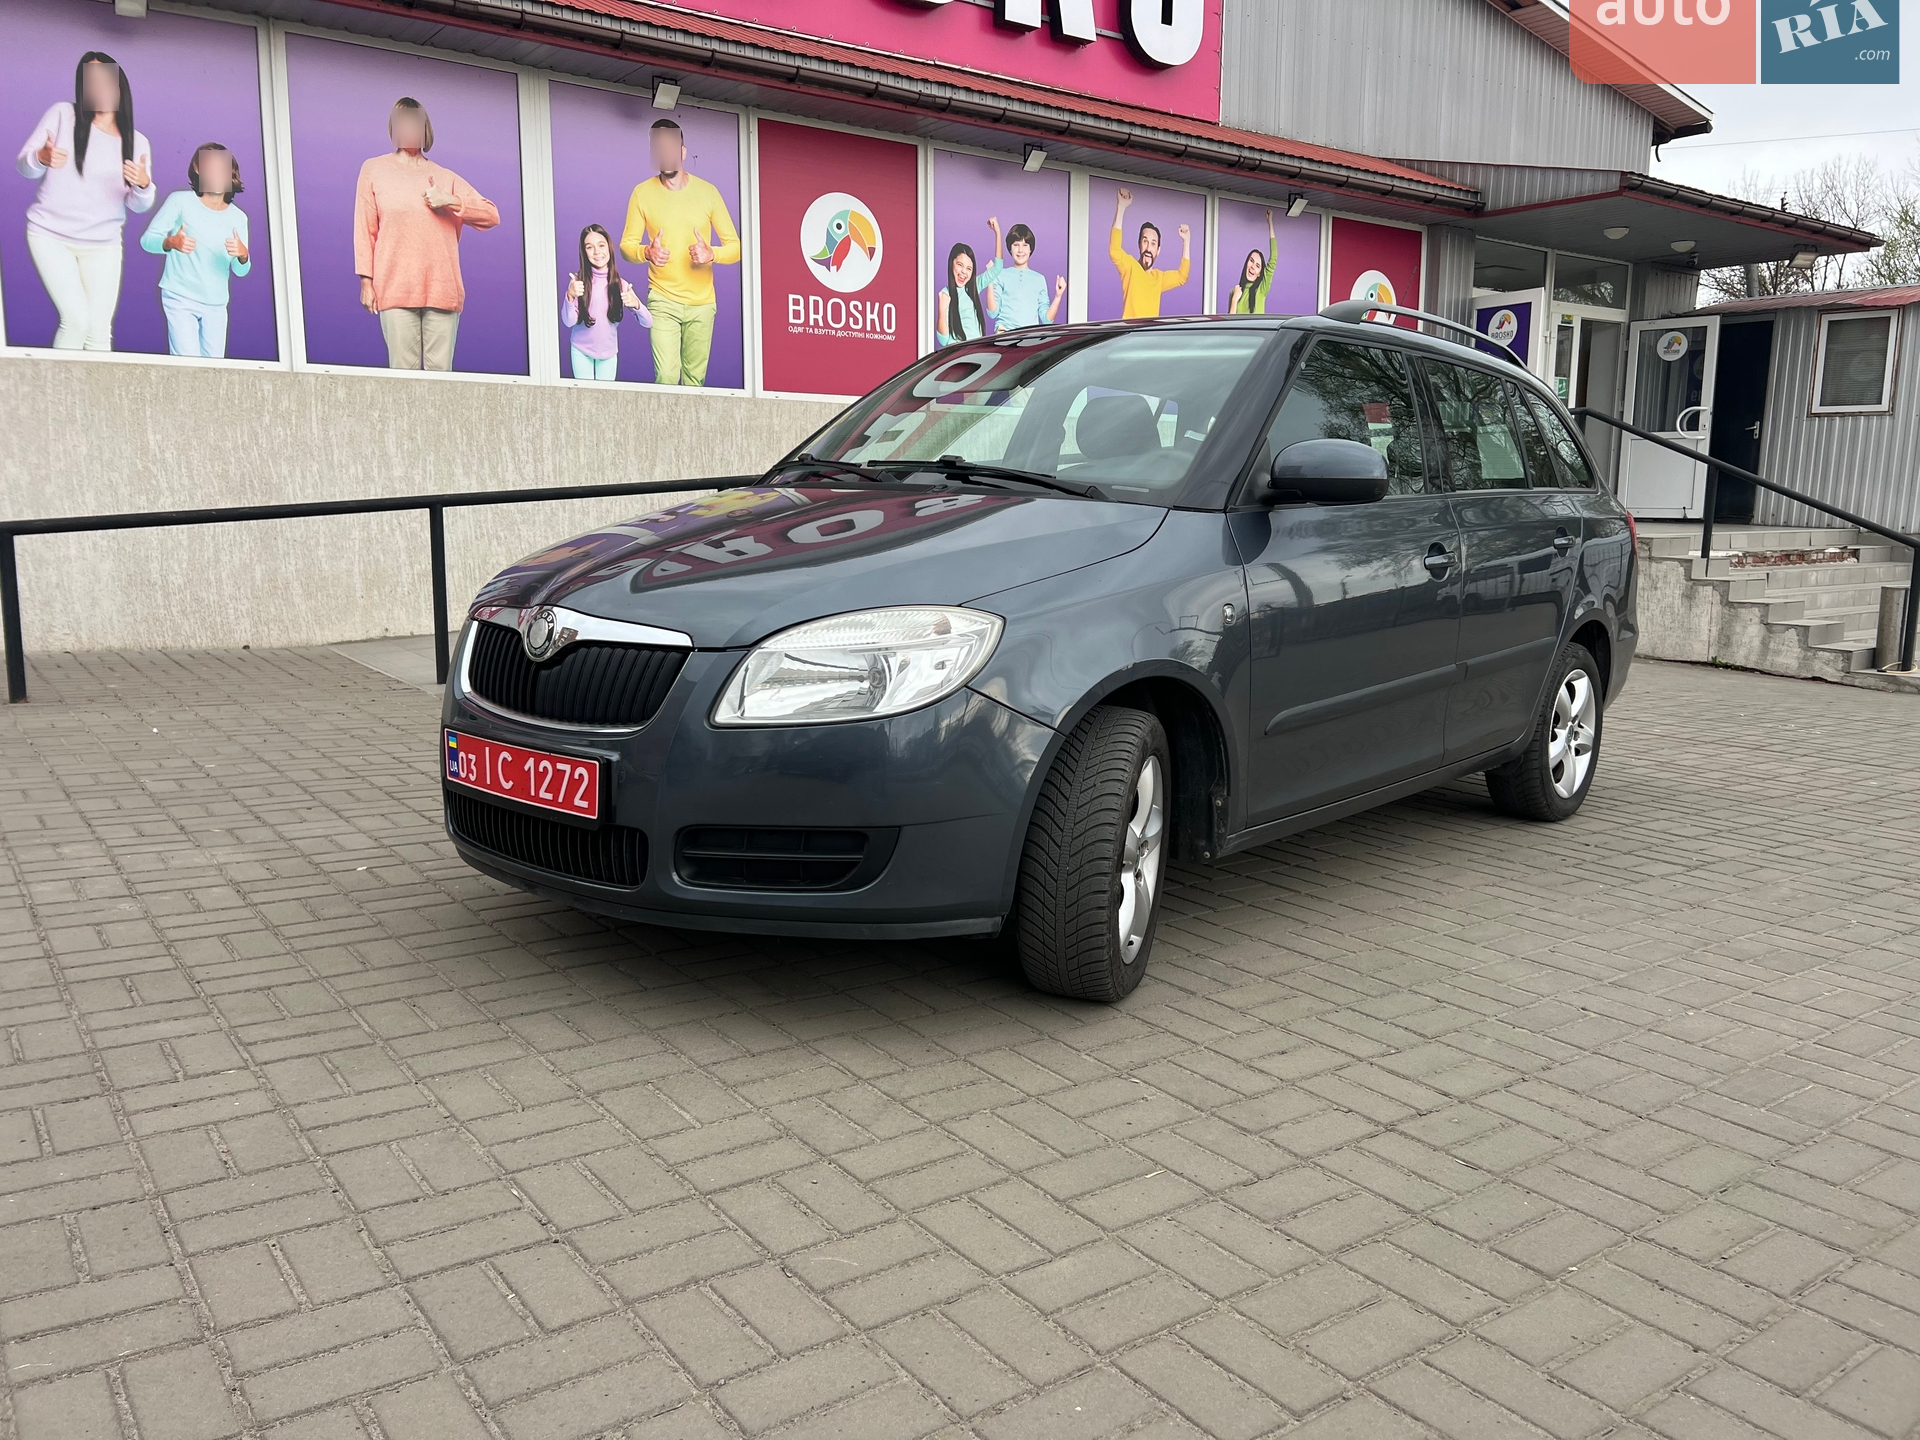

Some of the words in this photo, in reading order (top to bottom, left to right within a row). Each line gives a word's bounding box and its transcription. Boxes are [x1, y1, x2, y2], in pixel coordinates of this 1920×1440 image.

[788, 293, 896, 334] BROSKO
[788, 325, 804, 334] ОДЯГ
[814, 328, 836, 336] ВЗУТТЯ
[836, 330, 865, 338] ДОСТУПНІ
[866, 333, 896, 341] КОЖНОМУ
[449, 759, 459, 773] UA
[458, 751, 477, 782] 03
[523, 757, 590, 809] 1272
